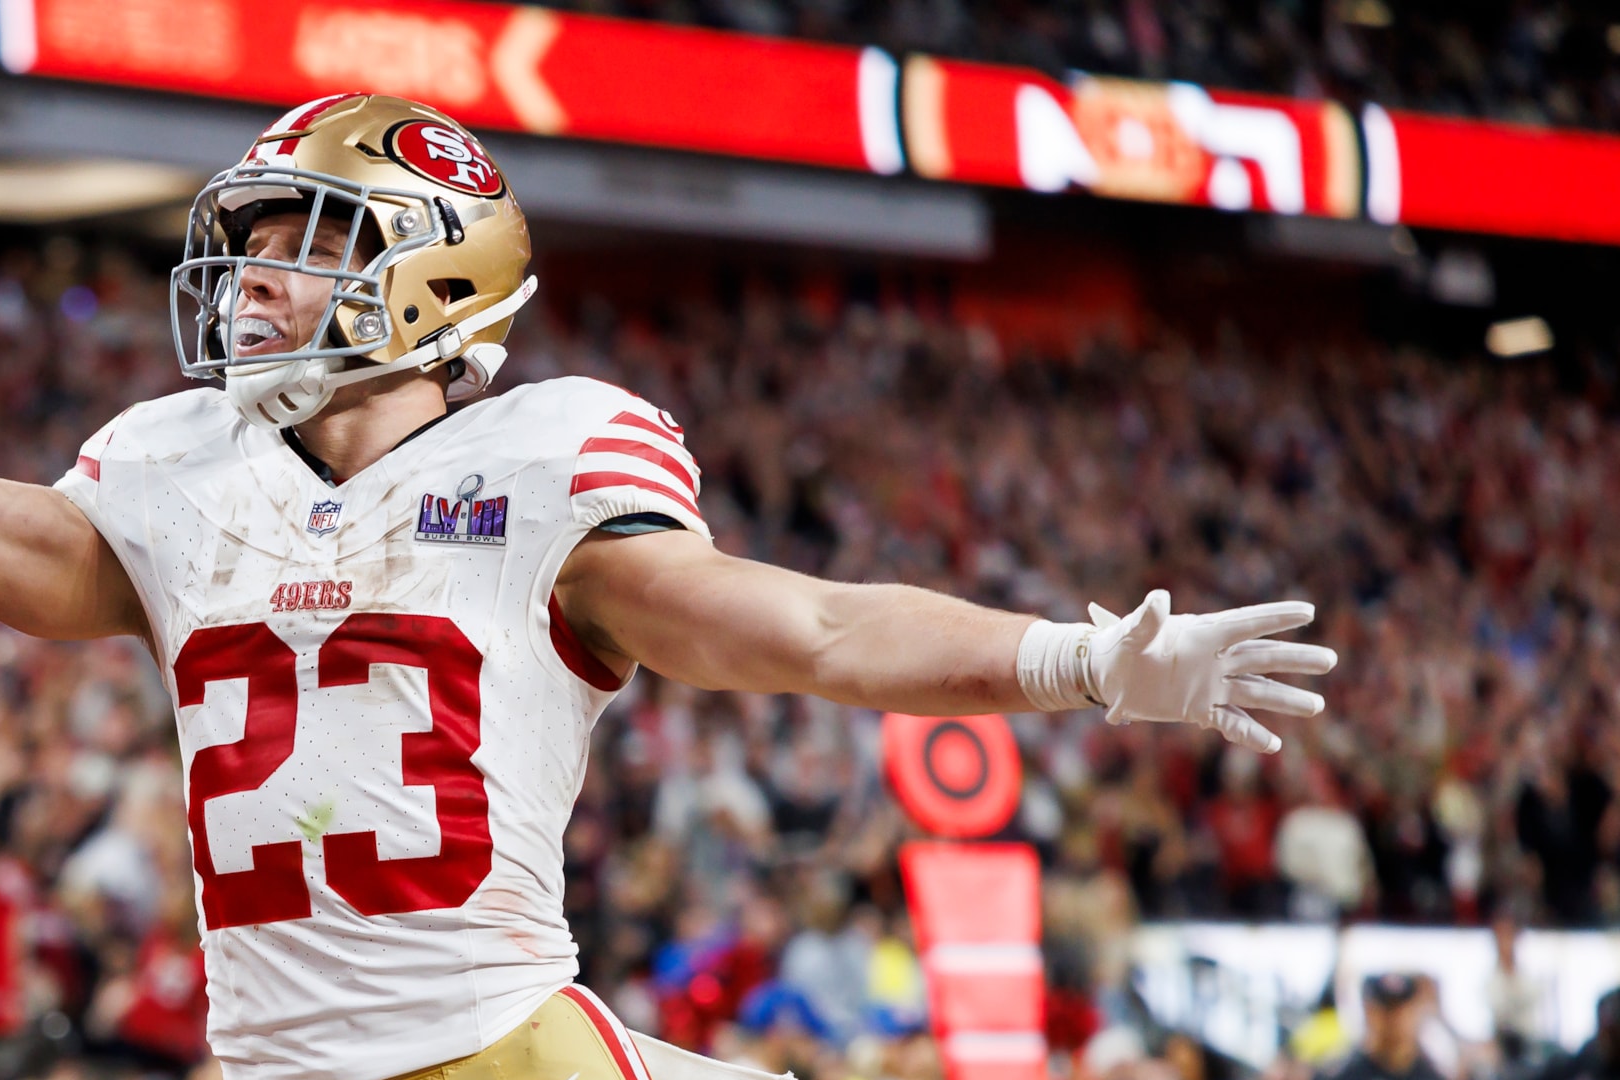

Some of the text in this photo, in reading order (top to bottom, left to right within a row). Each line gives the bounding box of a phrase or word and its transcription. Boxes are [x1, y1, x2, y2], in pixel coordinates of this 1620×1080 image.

[420, 126, 494, 193] SF
[310, 514, 334, 529] NFL
[424, 533, 498, 543] SUPER BOWL
[269, 580, 353, 613] 49ERS
[173, 613, 494, 931] 23
